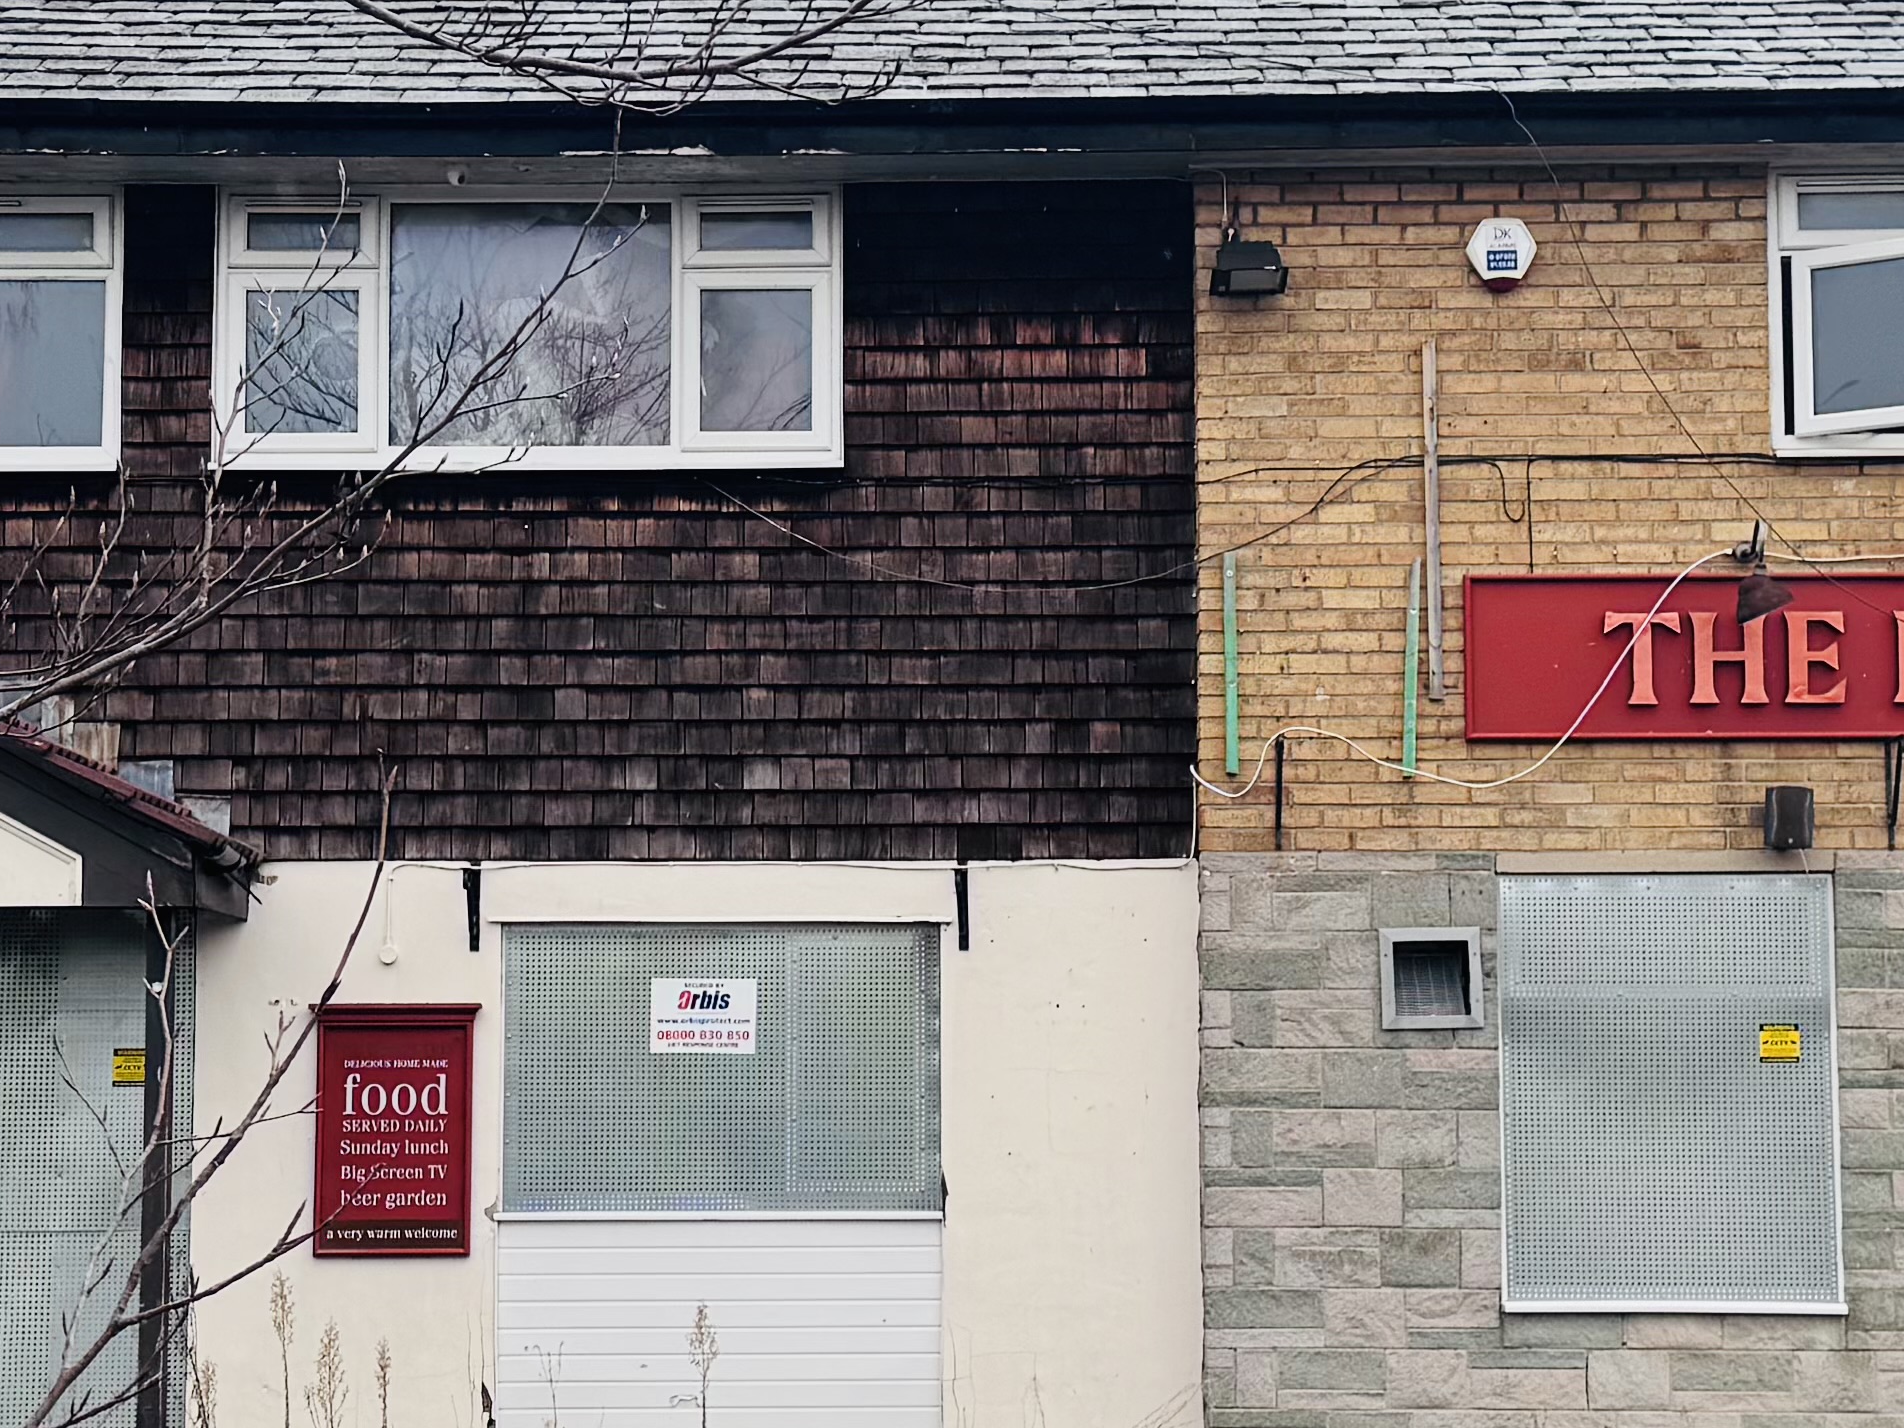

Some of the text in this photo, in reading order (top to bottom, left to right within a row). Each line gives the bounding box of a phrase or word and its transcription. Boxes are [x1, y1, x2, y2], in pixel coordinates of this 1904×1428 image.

[1603, 610, 1848, 705] THE
[677, 990, 731, 1010] Orbis
[657, 1030, 750, 1040] 08000 830 850
[344, 1059, 448, 1068] DELICIOUS HOME MADE
[342, 1073, 449, 1116] food
[342, 1119, 448, 1133] SERVED DAILY
[340, 1139, 449, 1157] Sunday lunch
[341, 1164, 448, 1183] Big Screen TV
[340, 1189, 447, 1209] beer garden
[326, 1227, 458, 1241] a very warm welcome
